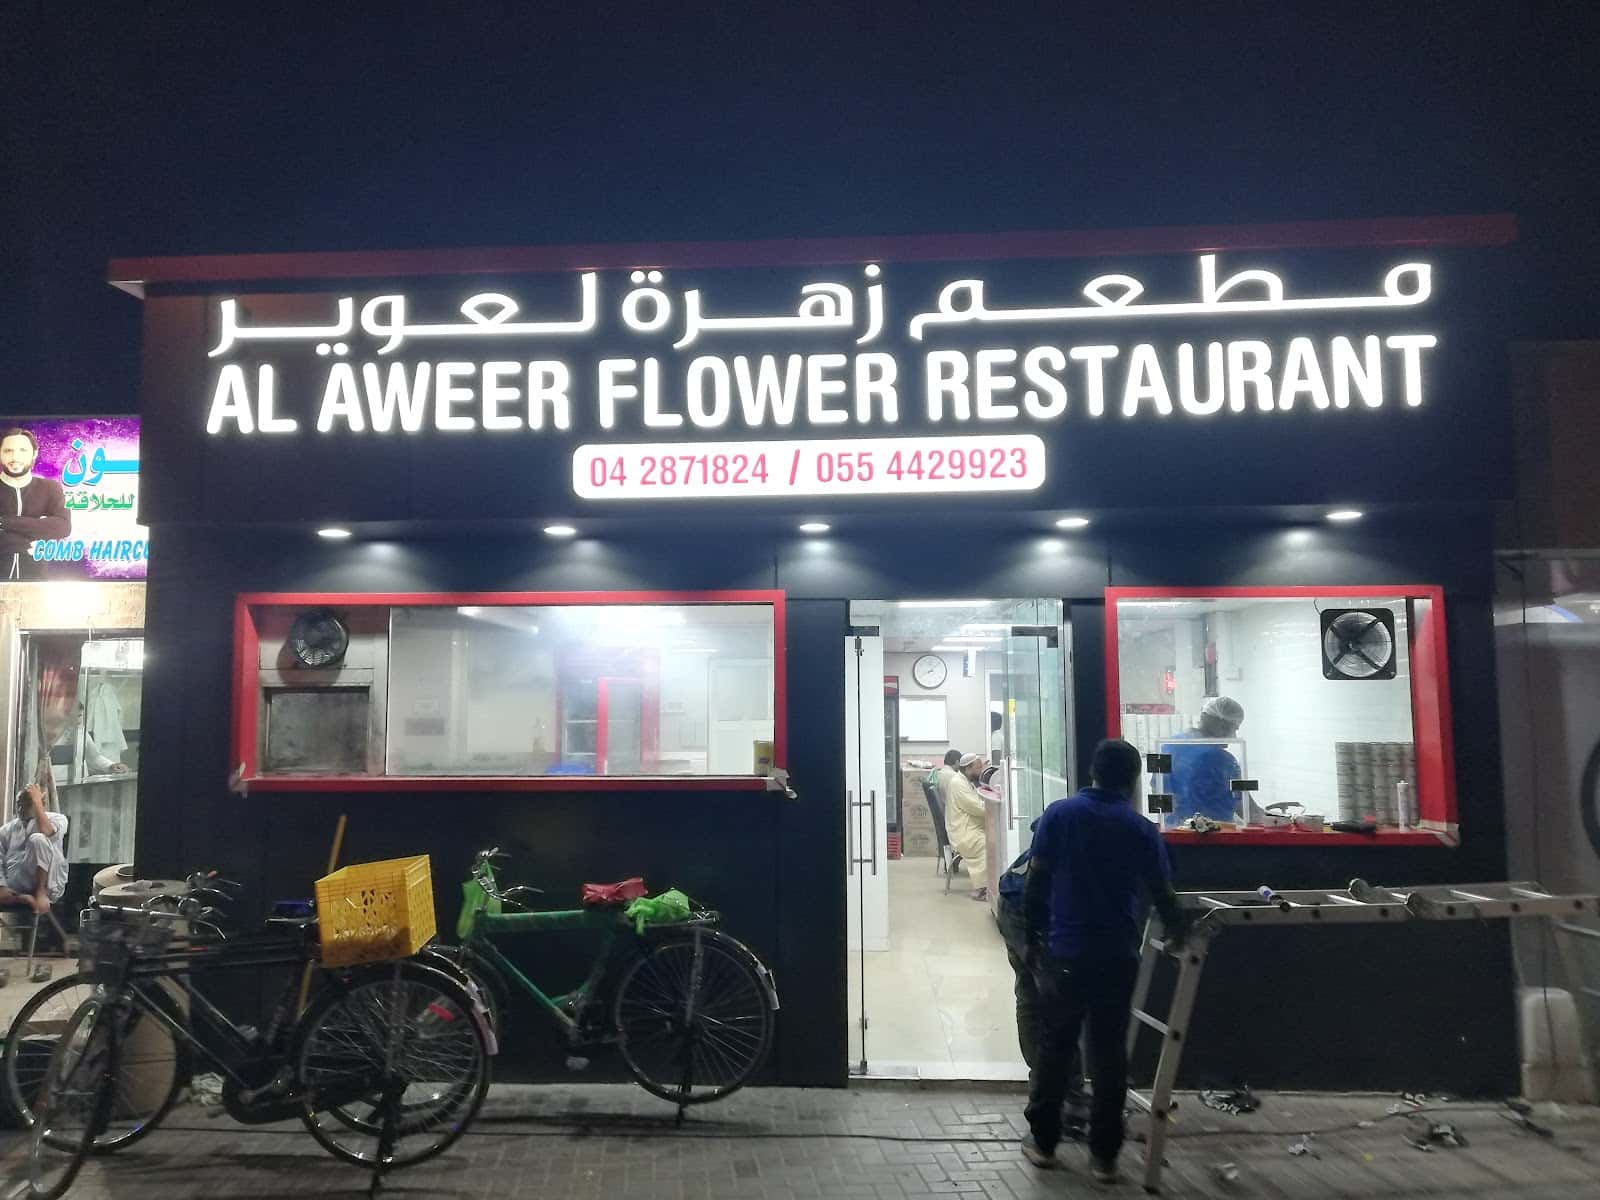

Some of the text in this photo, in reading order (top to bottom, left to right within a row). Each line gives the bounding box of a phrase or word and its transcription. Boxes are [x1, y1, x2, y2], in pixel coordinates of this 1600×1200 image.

[207, 253, 1432, 358] مطعم زهرة لعوير
[205, 334, 1437, 434] AL AWEER FLOWER RESTAURANT
[590, 457, 626, 487] 04
[639, 453, 768, 487] 2871824
[816, 452, 874, 483] 055
[886, 447, 1028, 482] 4429923
[33, 540, 84, 561] COMB
